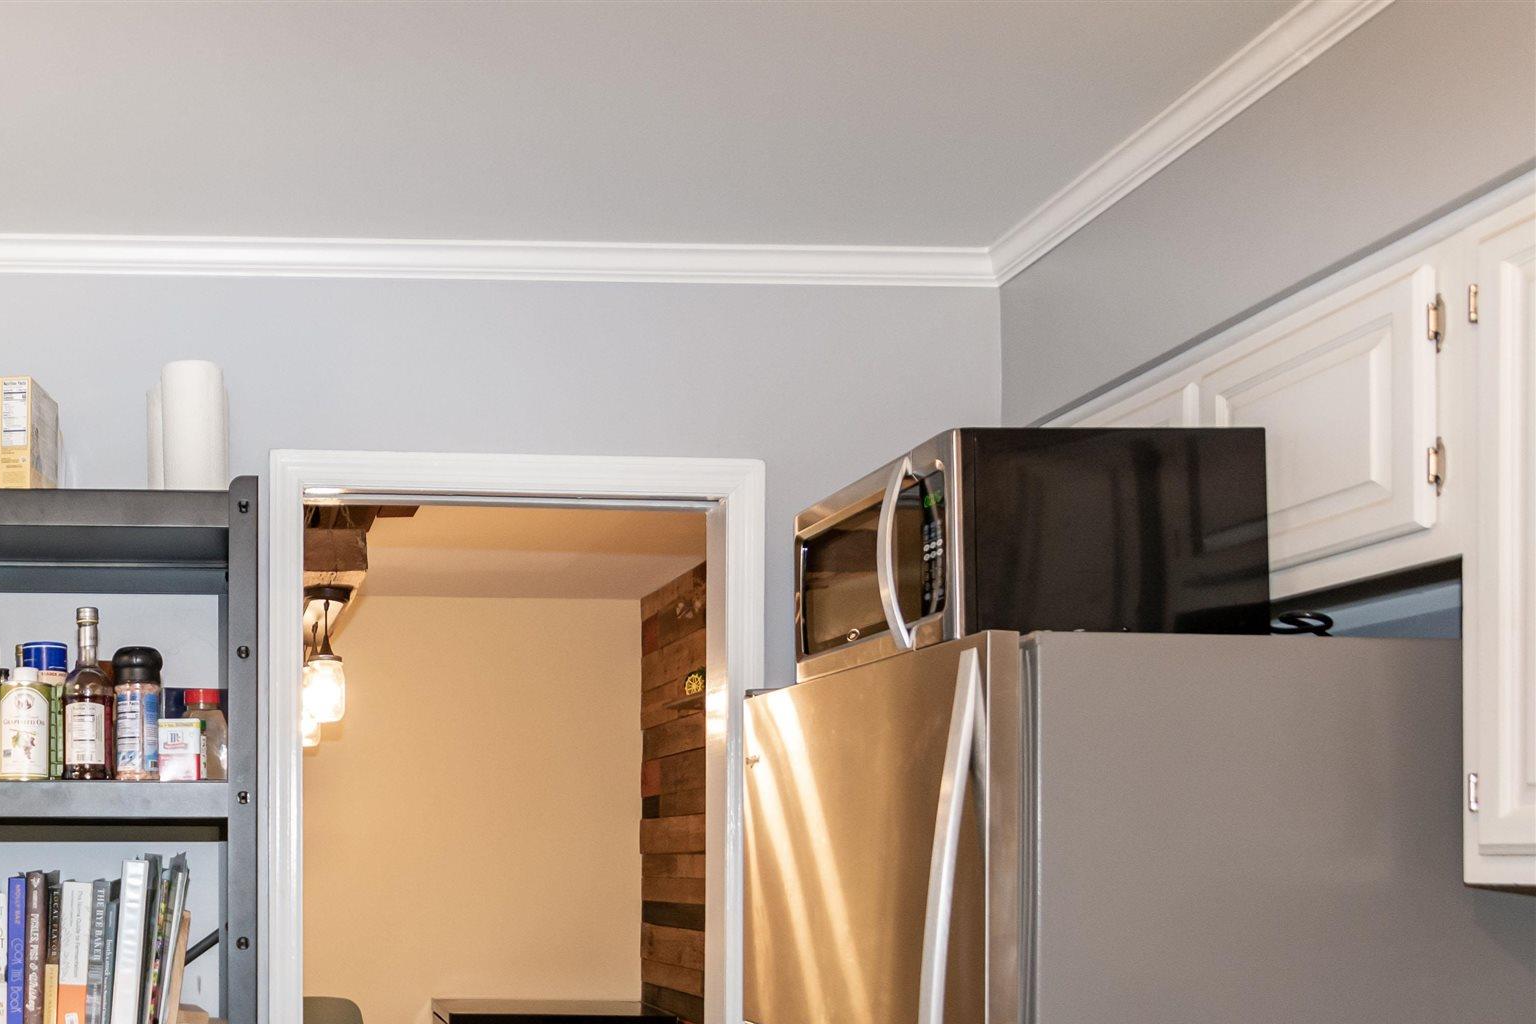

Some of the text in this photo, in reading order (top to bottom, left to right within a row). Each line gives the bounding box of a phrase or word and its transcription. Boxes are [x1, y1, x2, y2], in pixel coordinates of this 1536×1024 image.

[93, 888, 105, 961] THE RYE BAKER
[10, 938, 23, 1013] COOK THIS BOOK
